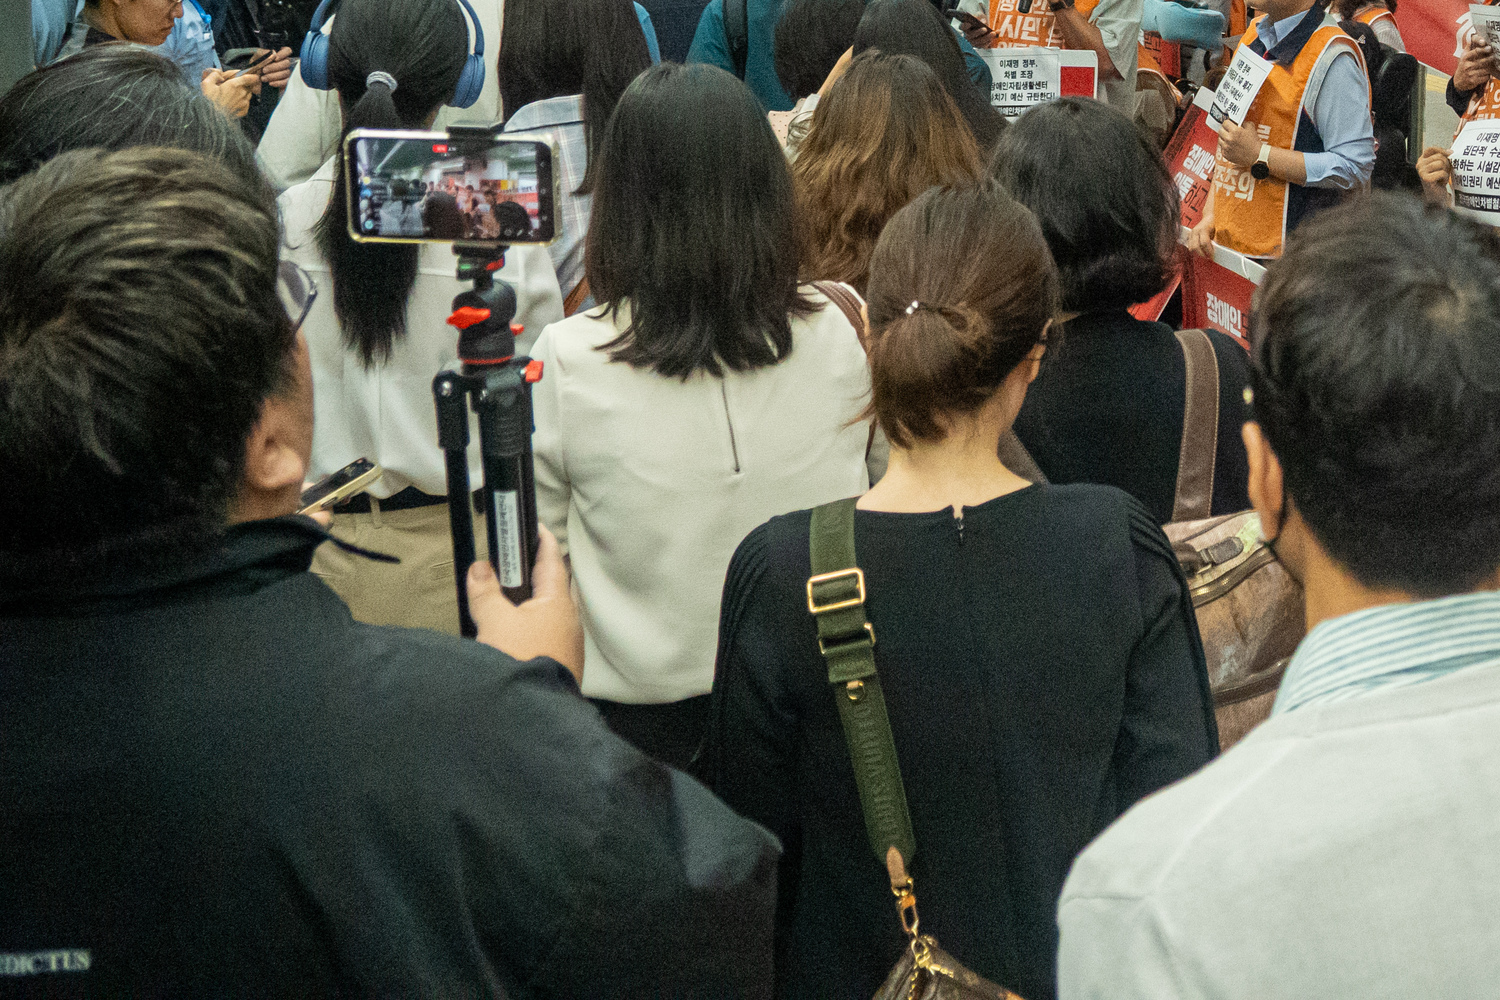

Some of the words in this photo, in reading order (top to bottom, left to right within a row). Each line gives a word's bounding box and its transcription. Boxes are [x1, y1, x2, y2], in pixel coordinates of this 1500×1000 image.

[999, 59, 1019, 68] 이재명
[1022, 59, 1038, 68] 정부,
[1003, 70, 1017, 79] 차별
[1019, 70, 1034, 79] 조장
[1010, 92, 1023, 101] 예산
[1026, 91, 1056, 101] 규탄한다!
[1476, 132, 1500, 144] 이재명
[1462, 145, 1487, 157] 집단적
[1182, 143, 1216, 182] 장애인
[1213, 163, 1256, 203] 주주의
[1486, 176, 1500, 190] 예산
